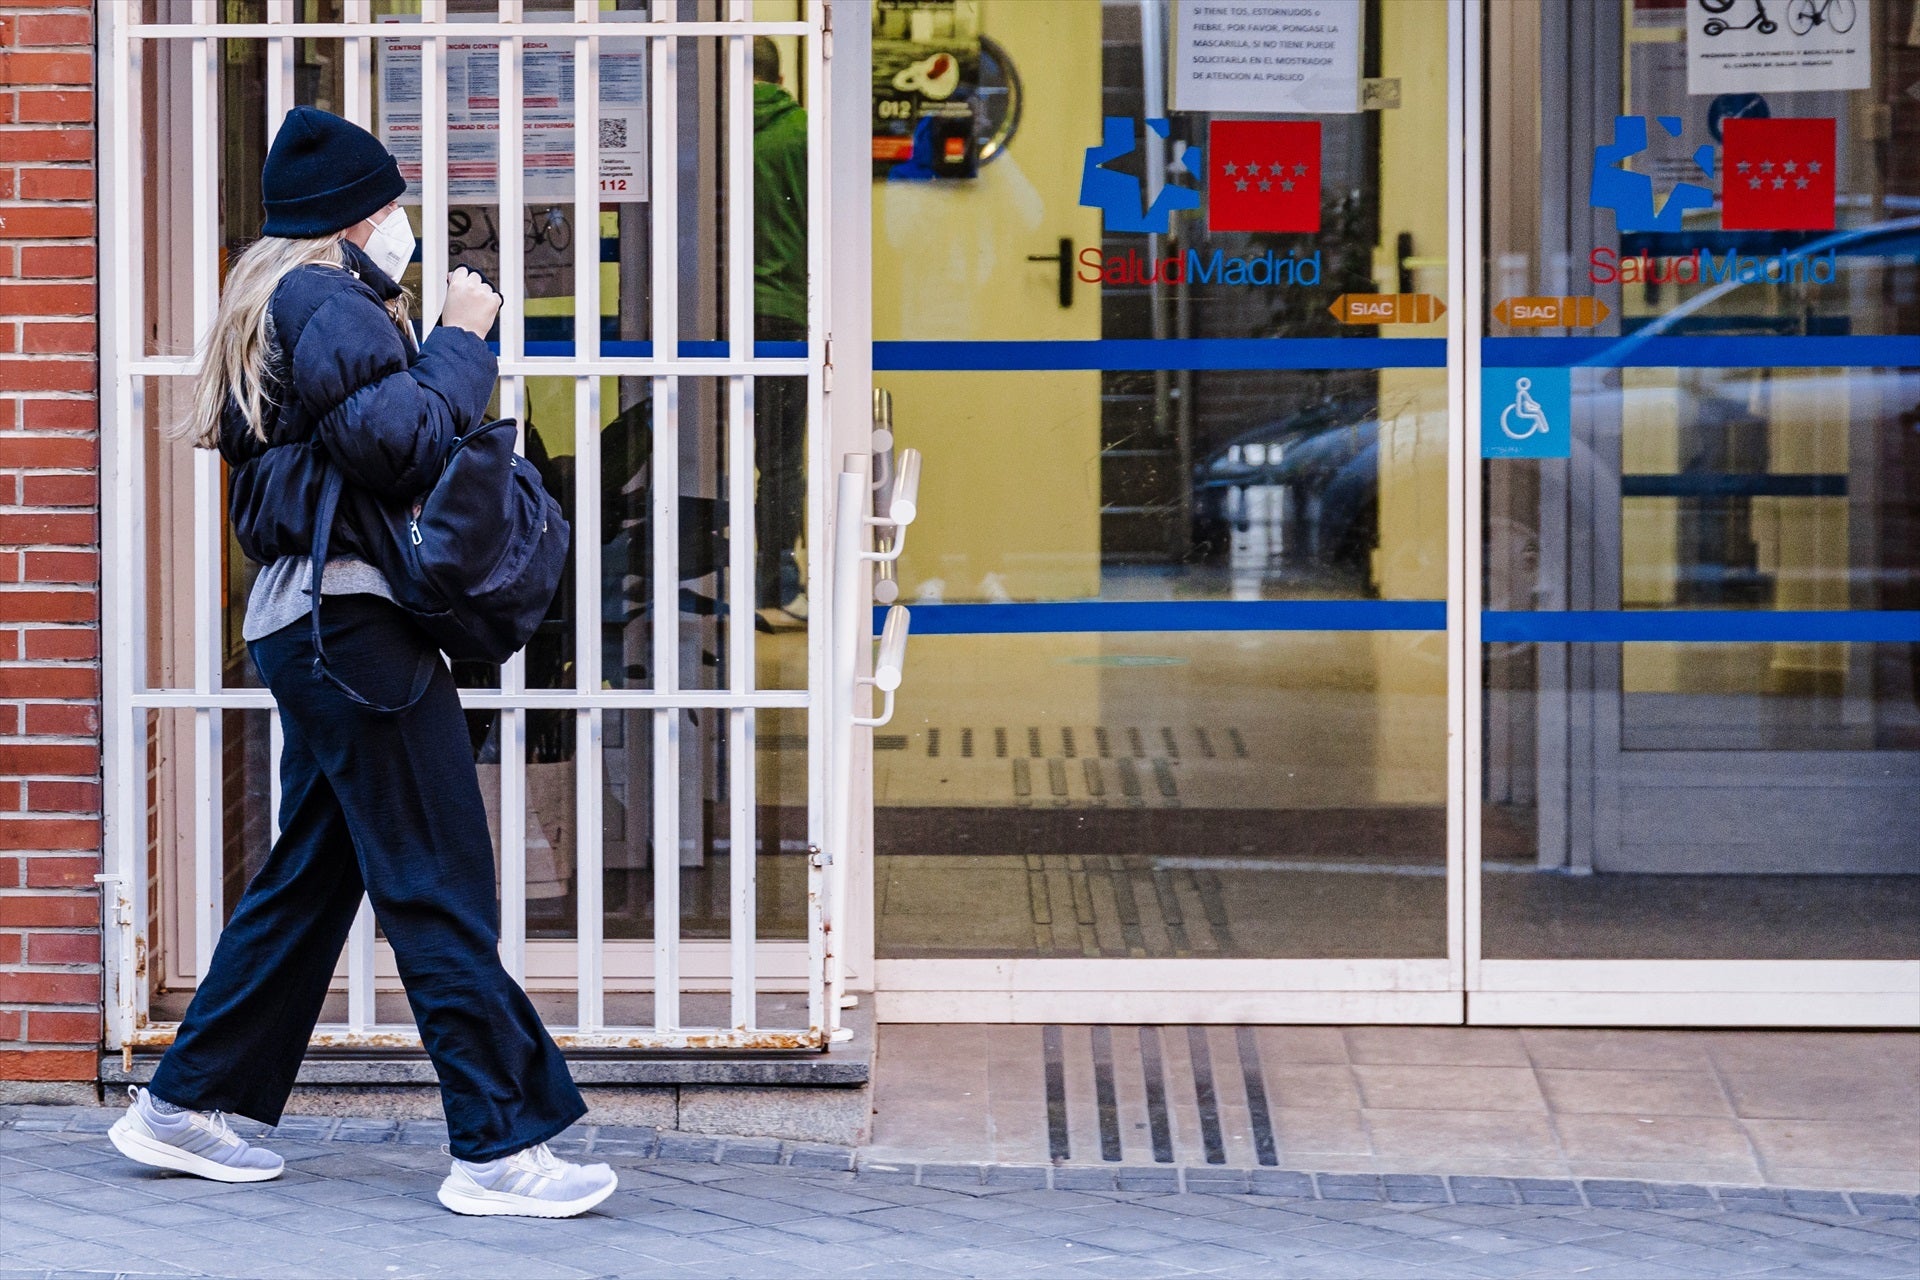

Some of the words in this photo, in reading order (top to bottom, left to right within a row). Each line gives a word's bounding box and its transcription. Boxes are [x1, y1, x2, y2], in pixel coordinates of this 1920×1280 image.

[1252, 8, 1312, 16] ESTORNUDOS
[1328, 25, 1339, 33] LA
[1306, 41, 1336, 49] PUEDE
[1276, 57, 1334, 65] MOSTRADOR
[878, 100, 912, 119] 012
[600, 179, 627, 191] 112
[1351, 302, 1393, 316] SIAC
[1513, 306, 1556, 319] SIAC
